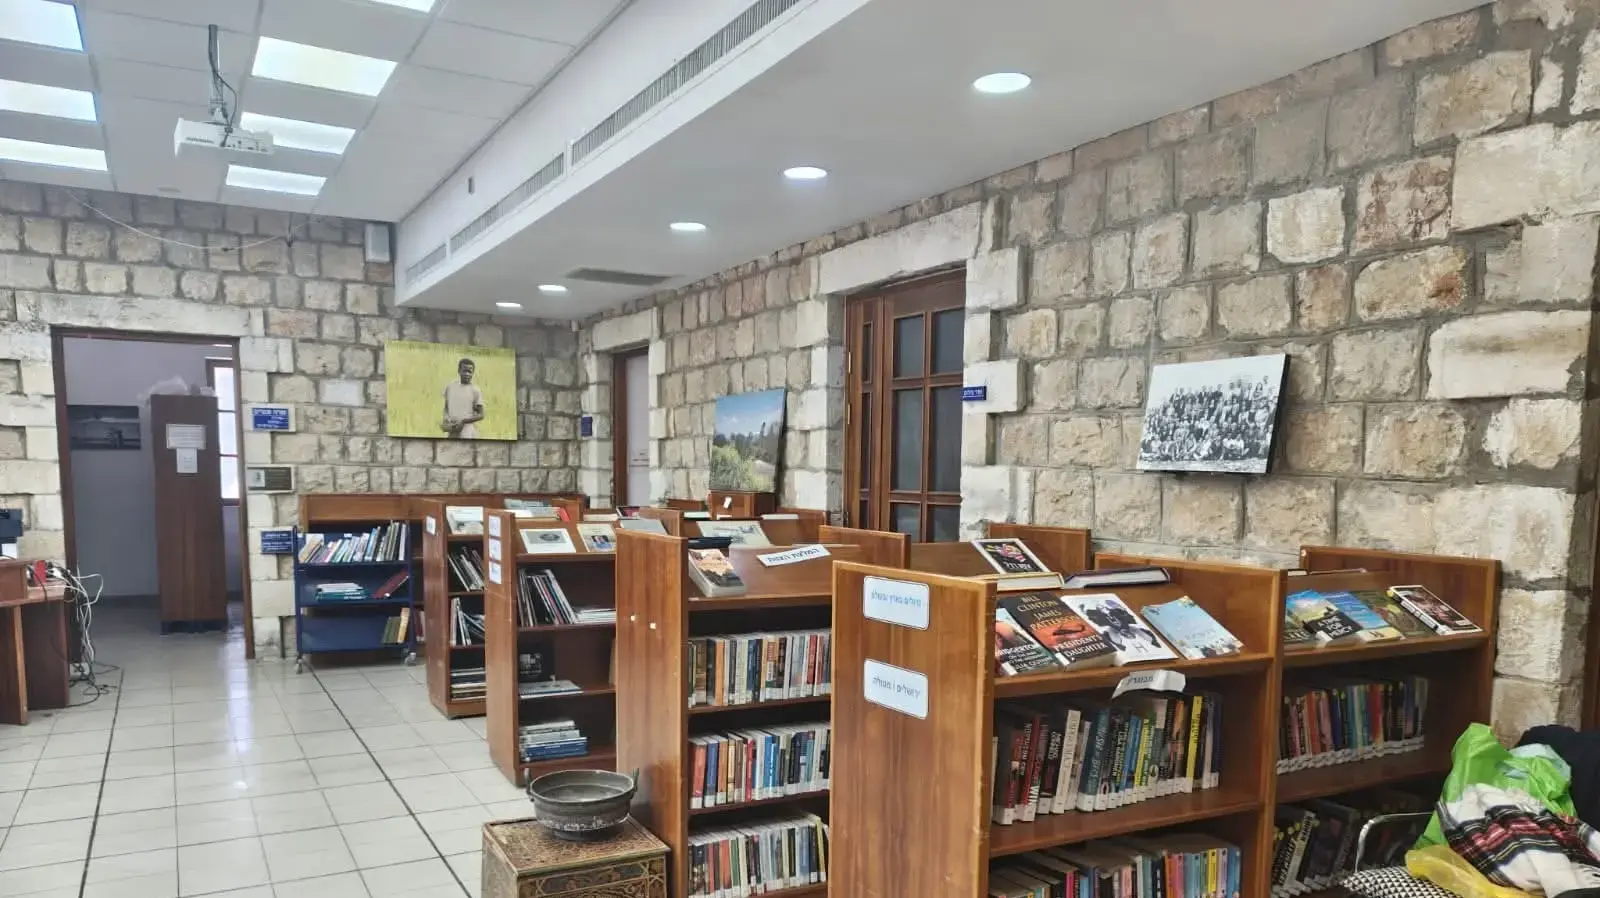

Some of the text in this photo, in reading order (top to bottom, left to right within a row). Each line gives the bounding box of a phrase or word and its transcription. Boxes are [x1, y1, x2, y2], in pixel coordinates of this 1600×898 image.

[1017, 599, 1058, 612] CLINTON
[1021, 595, 1041, 603] BILL
[1033, 610, 1062, 620] JAMES
[1029, 615, 1081, 631] PATTERSON
[1064, 642, 1109, 657] DAUGHTER
